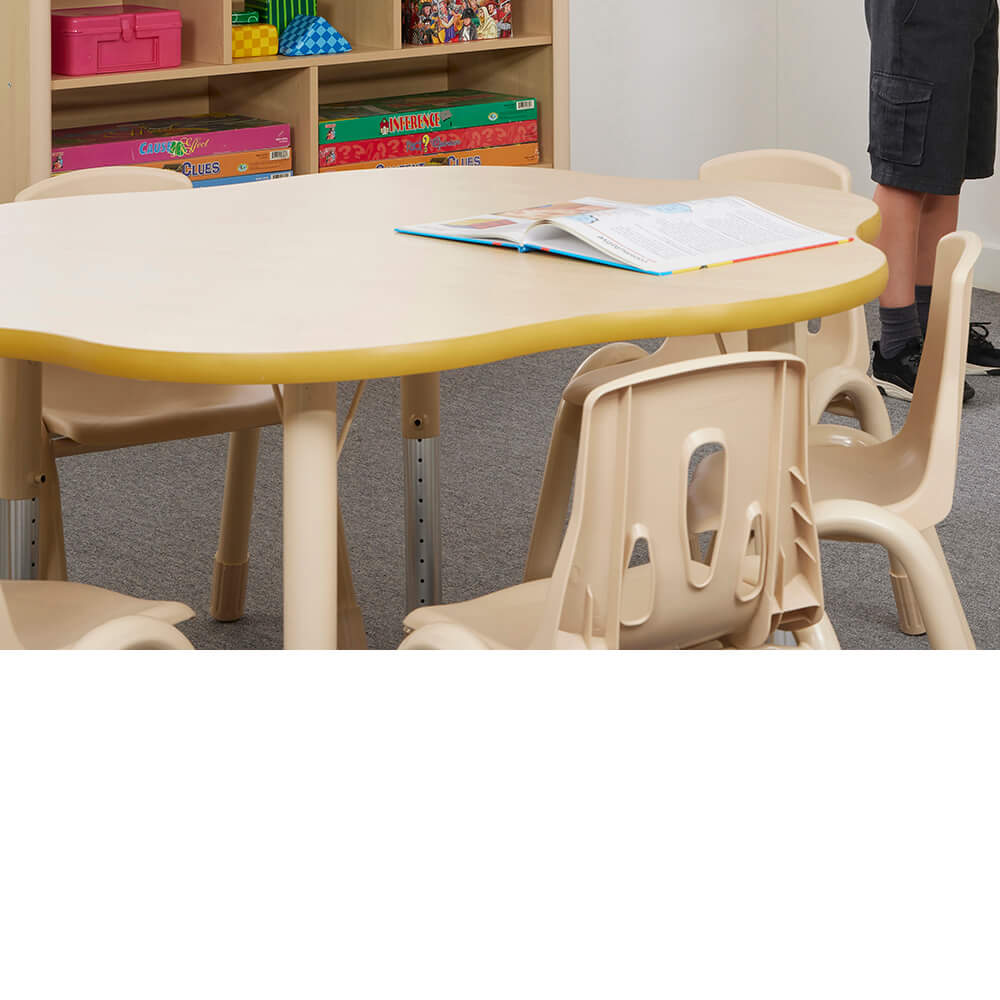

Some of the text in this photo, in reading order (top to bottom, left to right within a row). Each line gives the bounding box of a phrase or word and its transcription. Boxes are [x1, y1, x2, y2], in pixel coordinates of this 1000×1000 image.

[389, 112, 441, 133] INFERENCE
[139, 141, 172, 155] CAUSE
[182, 161, 220, 176] CLUES
